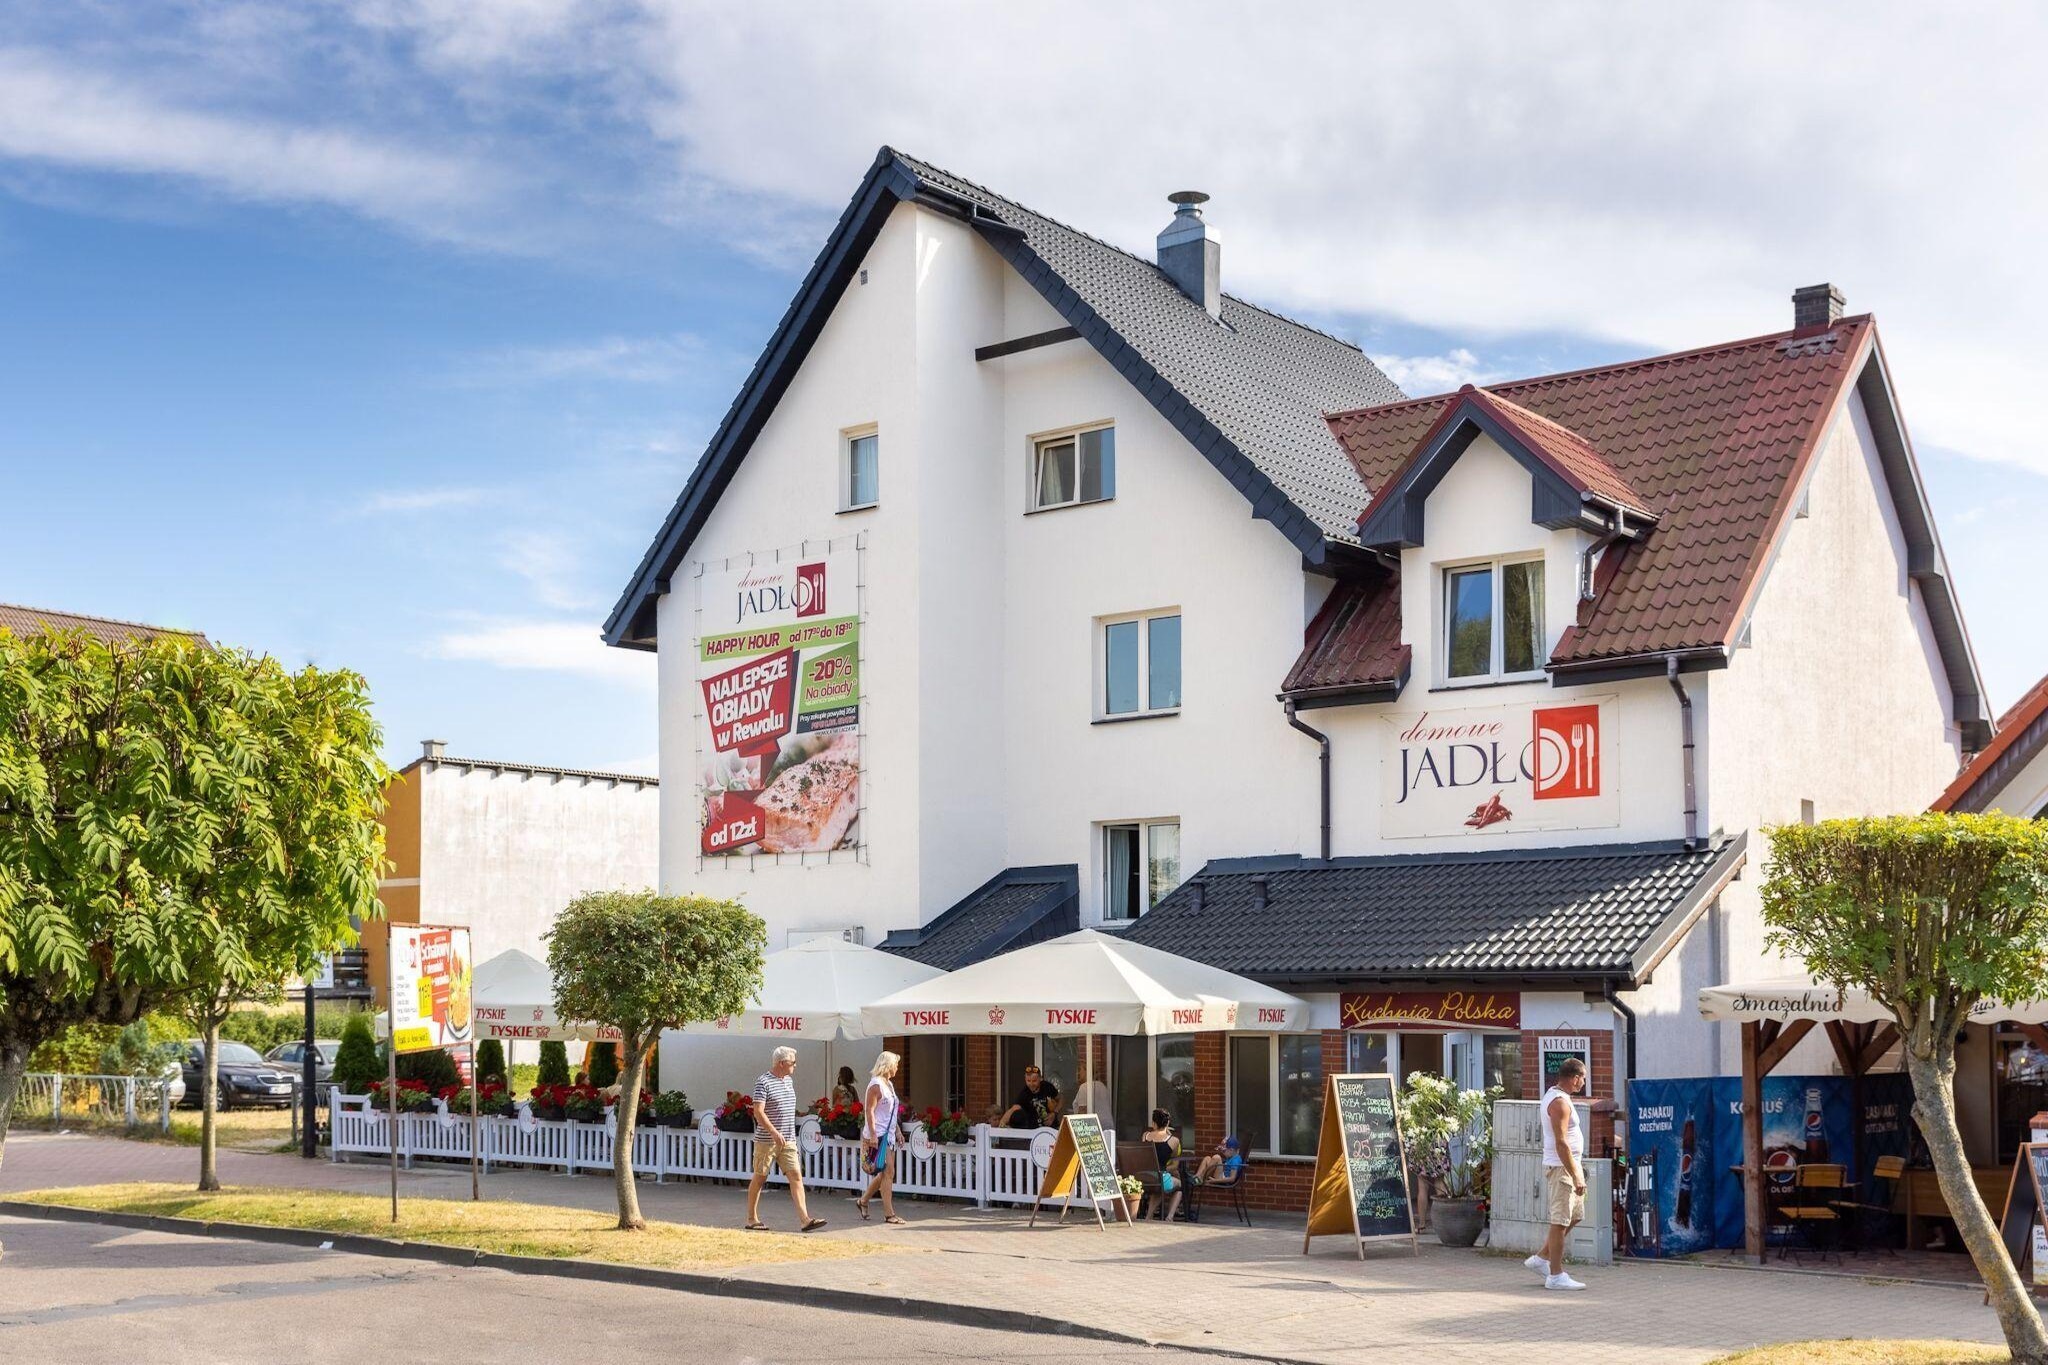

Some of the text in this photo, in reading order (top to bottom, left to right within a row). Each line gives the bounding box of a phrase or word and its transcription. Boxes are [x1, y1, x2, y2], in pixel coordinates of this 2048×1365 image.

[738, 570, 784, 588] domowe
[706, 636, 746, 655] HAPPY
[747, 632, 780, 650] HOUR
[789, 631, 801, 643] od
[820, 625, 832, 638] do
[808, 656, 852, 682] -20%
[709, 656, 788, 703] NAJLEPSZE
[806, 687, 818, 699] Na
[712, 685, 774, 727] OBIADY
[717, 731, 730, 747] w
[733, 710, 783, 743] Rewalu
[1400, 712, 1503, 743] domowe
[711, 816, 757, 846] od 12zł
[476, 1008, 506, 1020] TYSKIE
[1258, 1008, 1287, 1023] TYSKIE
[1343, 991, 1516, 1024] Kuchnia Polska
[762, 1016, 803, 1031] TYSKIE
[903, 1010, 950, 1026] TYSKIE
[1045, 1009, 1097, 1025] TYSKIE
[1172, 1009, 1204, 1024] TYSKIE
[489, 1025, 533, 1038] TYSKIE
[1543, 1039, 1586, 1050] KITCHEN
[1638, 1106, 1674, 1121] ZASMAKUJ
[1638, 1121, 1673, 1132] ORZEŹWIENIA
[1353, 1139, 1372, 1158] 25
